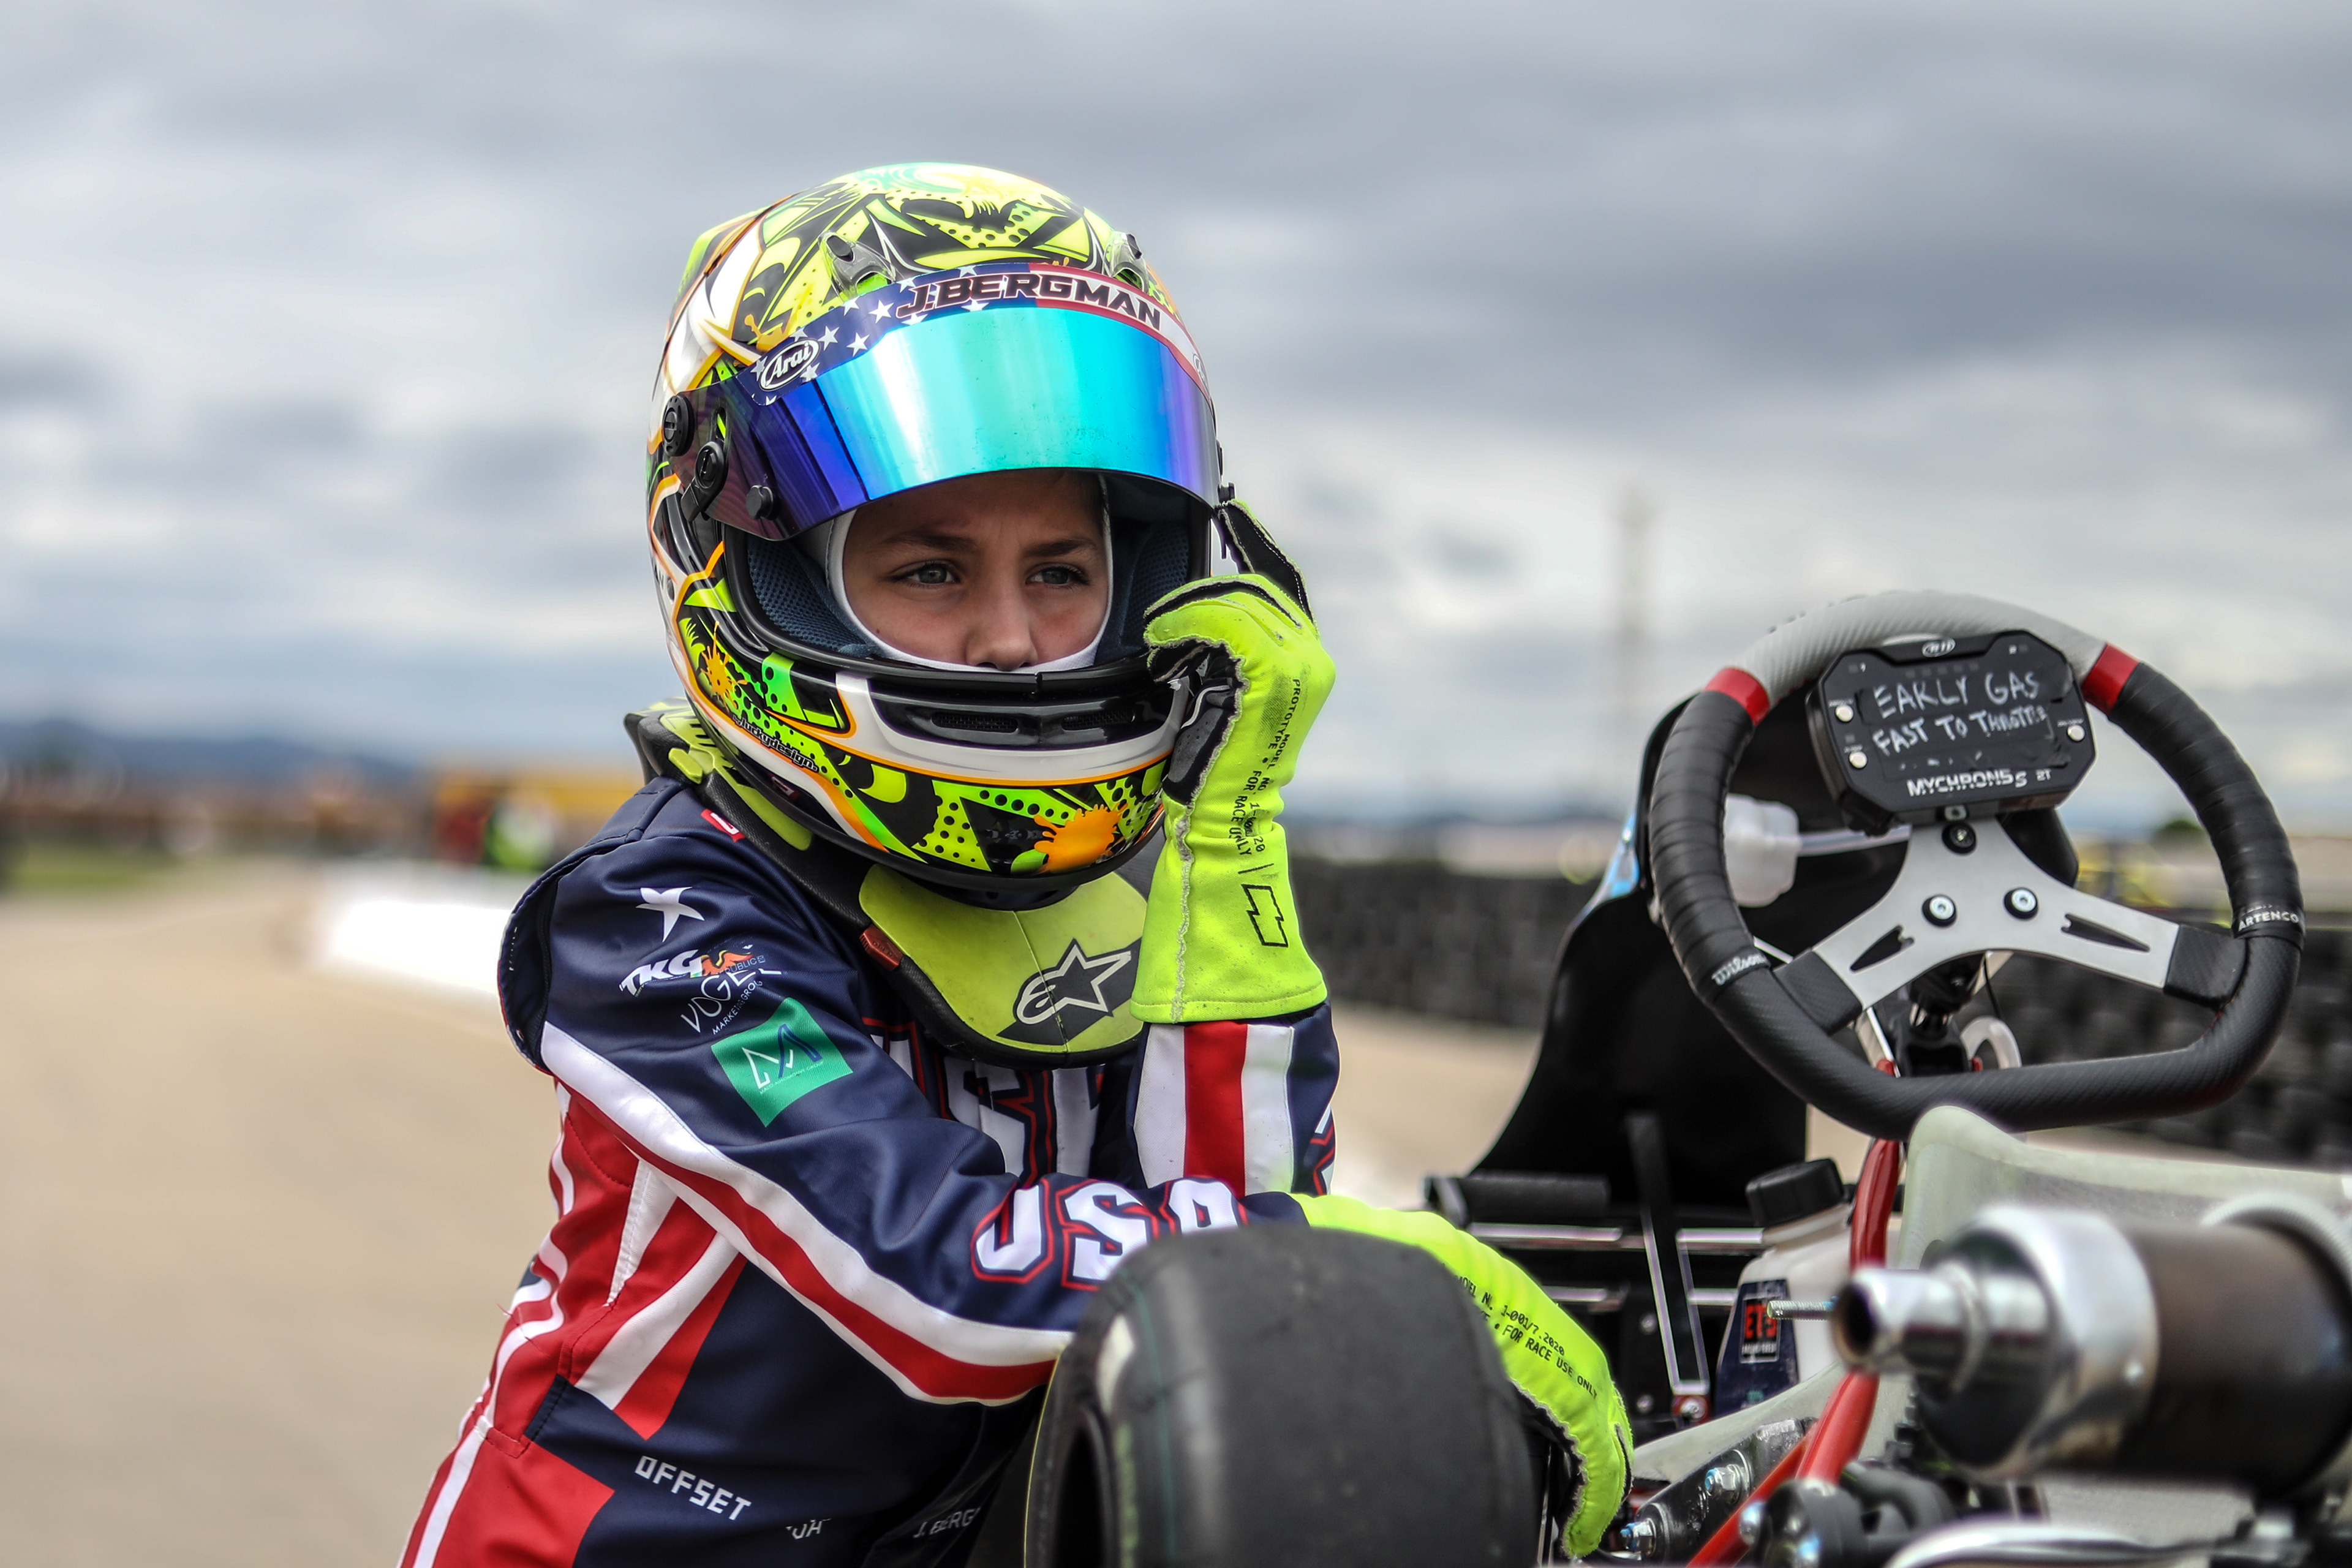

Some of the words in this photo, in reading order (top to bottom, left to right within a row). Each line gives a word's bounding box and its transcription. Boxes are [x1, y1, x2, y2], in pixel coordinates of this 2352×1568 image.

[895, 273, 1161, 333] J.BERGMAN
[771, 339, 816, 381] Arai
[1984, 671, 2040, 705] GAS
[1268, 679, 1301, 750] PROTOTYPE
[1872, 717, 1929, 757] FAST
[1934, 714, 1968, 742] TO
[1267, 734, 1291, 770] MODEL
[1243, 770, 1262, 791] FOR
[1231, 795, 1248, 823] RACE
[972, 1176, 1247, 1290] USA
[1502, 1323, 1524, 1344] FOR
[1525, 1337, 1553, 1362] RACE
[1556, 1357, 1574, 1378] USE
[1577, 1375, 1598, 1400] ONLY
[635, 1455, 752, 1521] OFFSET
